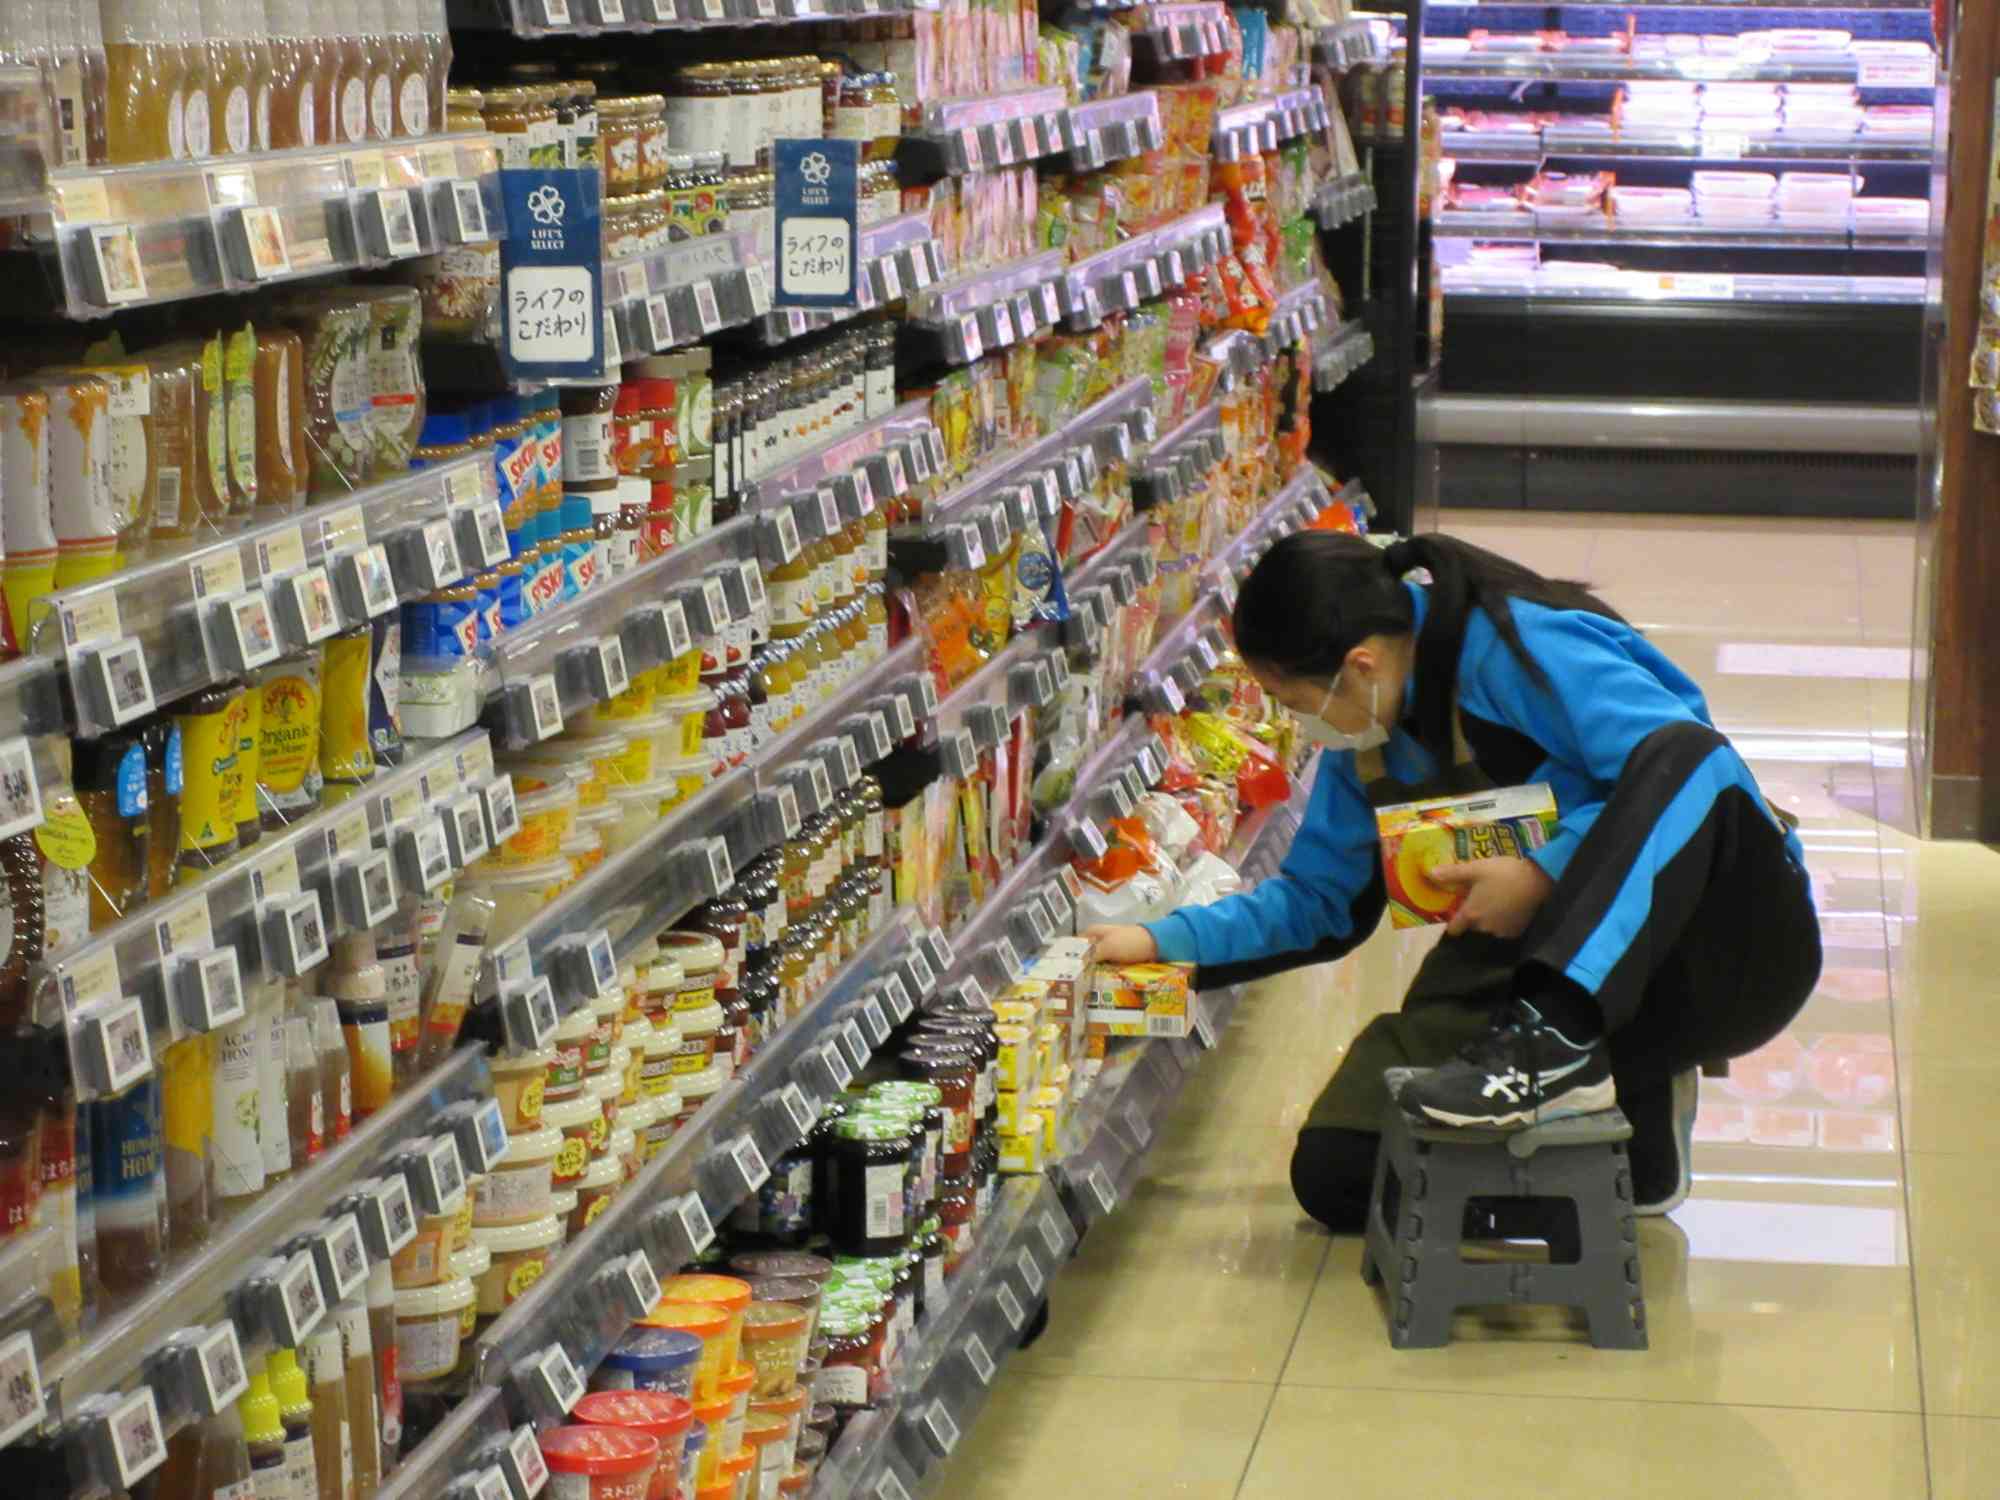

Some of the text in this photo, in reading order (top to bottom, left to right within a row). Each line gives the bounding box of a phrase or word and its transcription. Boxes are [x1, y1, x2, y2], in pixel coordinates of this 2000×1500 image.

[787, 234, 844, 255] ライフの
[789, 253, 845, 277] こだわり
[514, 287, 585, 313] ライフの
[518, 311, 586, 340] こだわり
